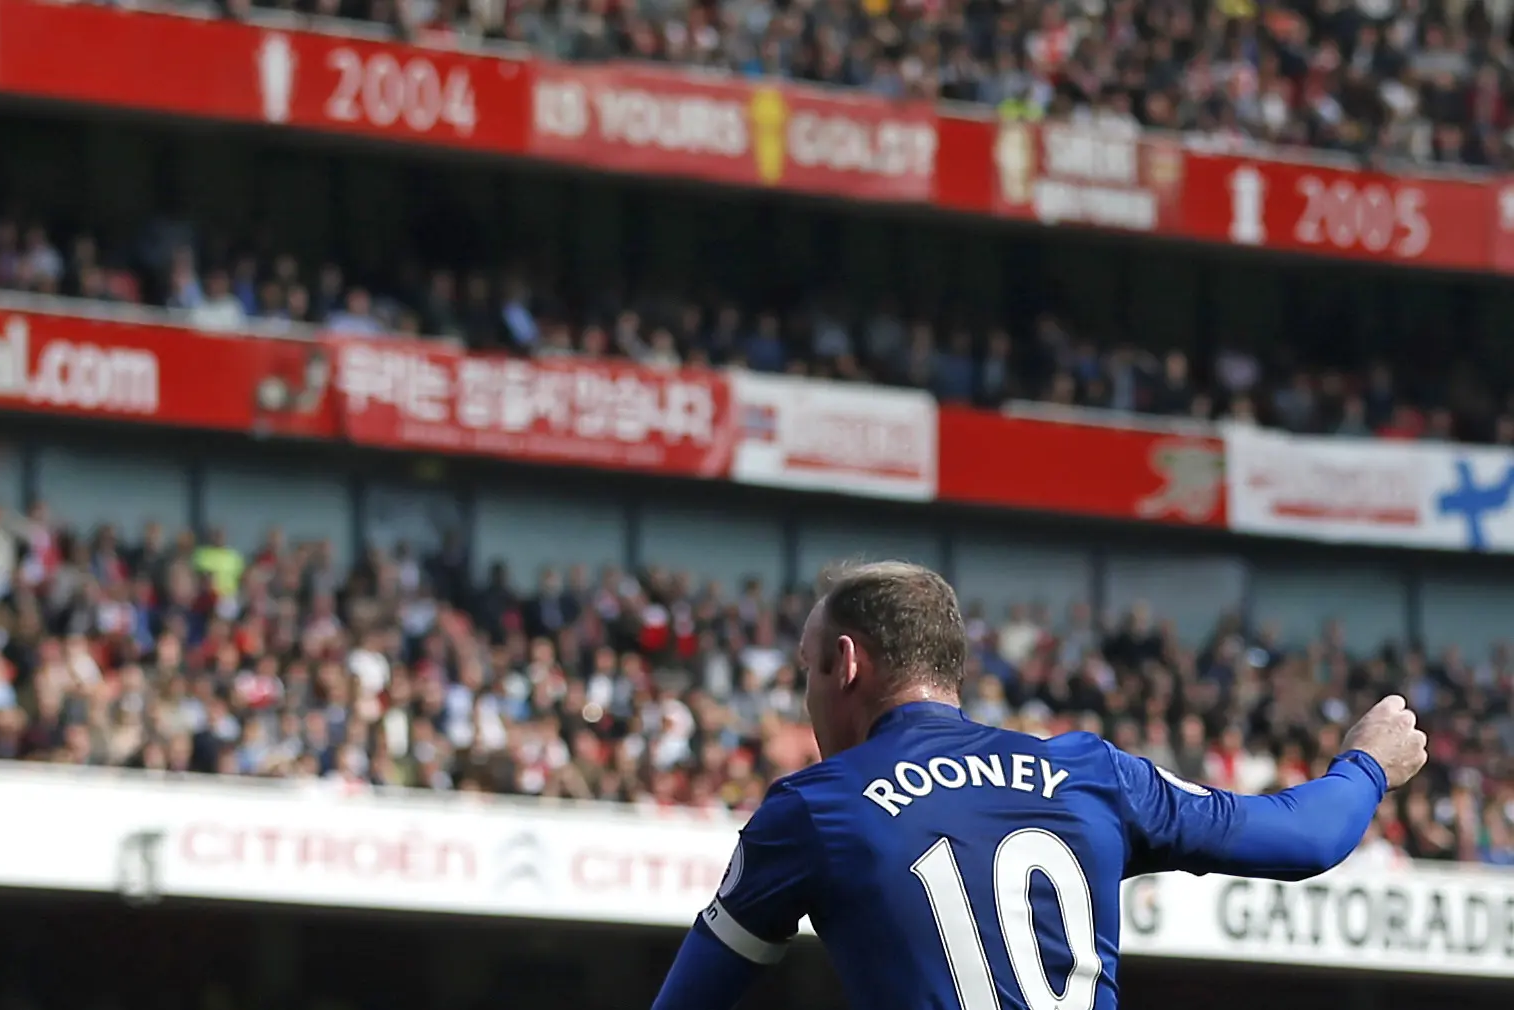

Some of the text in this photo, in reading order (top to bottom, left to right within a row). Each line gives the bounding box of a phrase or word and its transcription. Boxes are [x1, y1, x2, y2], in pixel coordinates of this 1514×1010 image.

[325, 47, 476, 136] 2004
[1295, 175, 1431, 257] 2005
[863, 754, 1069, 817] ROONEY
